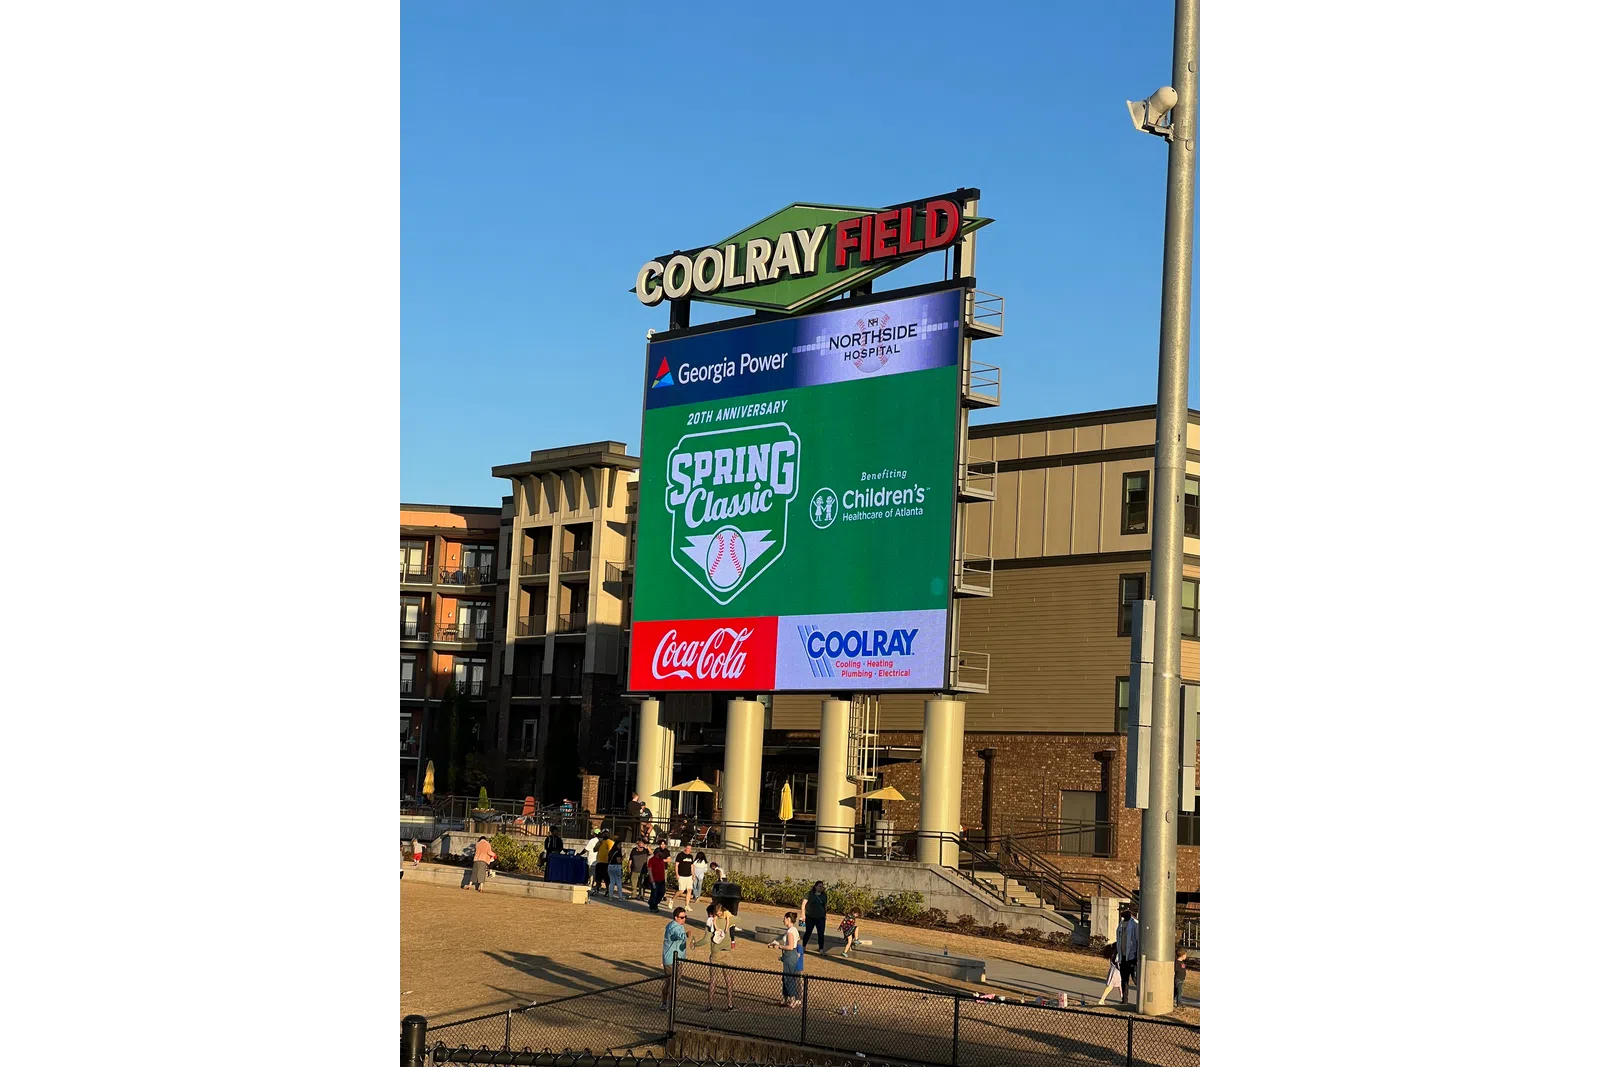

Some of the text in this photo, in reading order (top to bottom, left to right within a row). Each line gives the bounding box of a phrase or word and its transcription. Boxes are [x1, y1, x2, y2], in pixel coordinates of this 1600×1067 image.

[635, 200, 960, 306] COOLRAY FIELD
[829, 323, 918, 350] NORTHSIDE
[844, 344, 900, 361] HOSPITAL
[678, 352, 789, 385] Georgia Power
[686, 399, 789, 426] 20TH ANNIVERSARY
[669, 440, 796, 506] SPRING
[860, 468, 907, 482] Benefiting
[684, 481, 773, 529] Classic
[842, 483, 925, 510] Children's
[842, 506, 924, 522] Healthcare of Atlanta
[652, 627, 755, 680] Coca-Cola
[807, 628, 919, 659] COOLRAY
[835, 659, 894, 669] Cooling Heating
[841, 668, 911, 679] Plumbing Electrical
